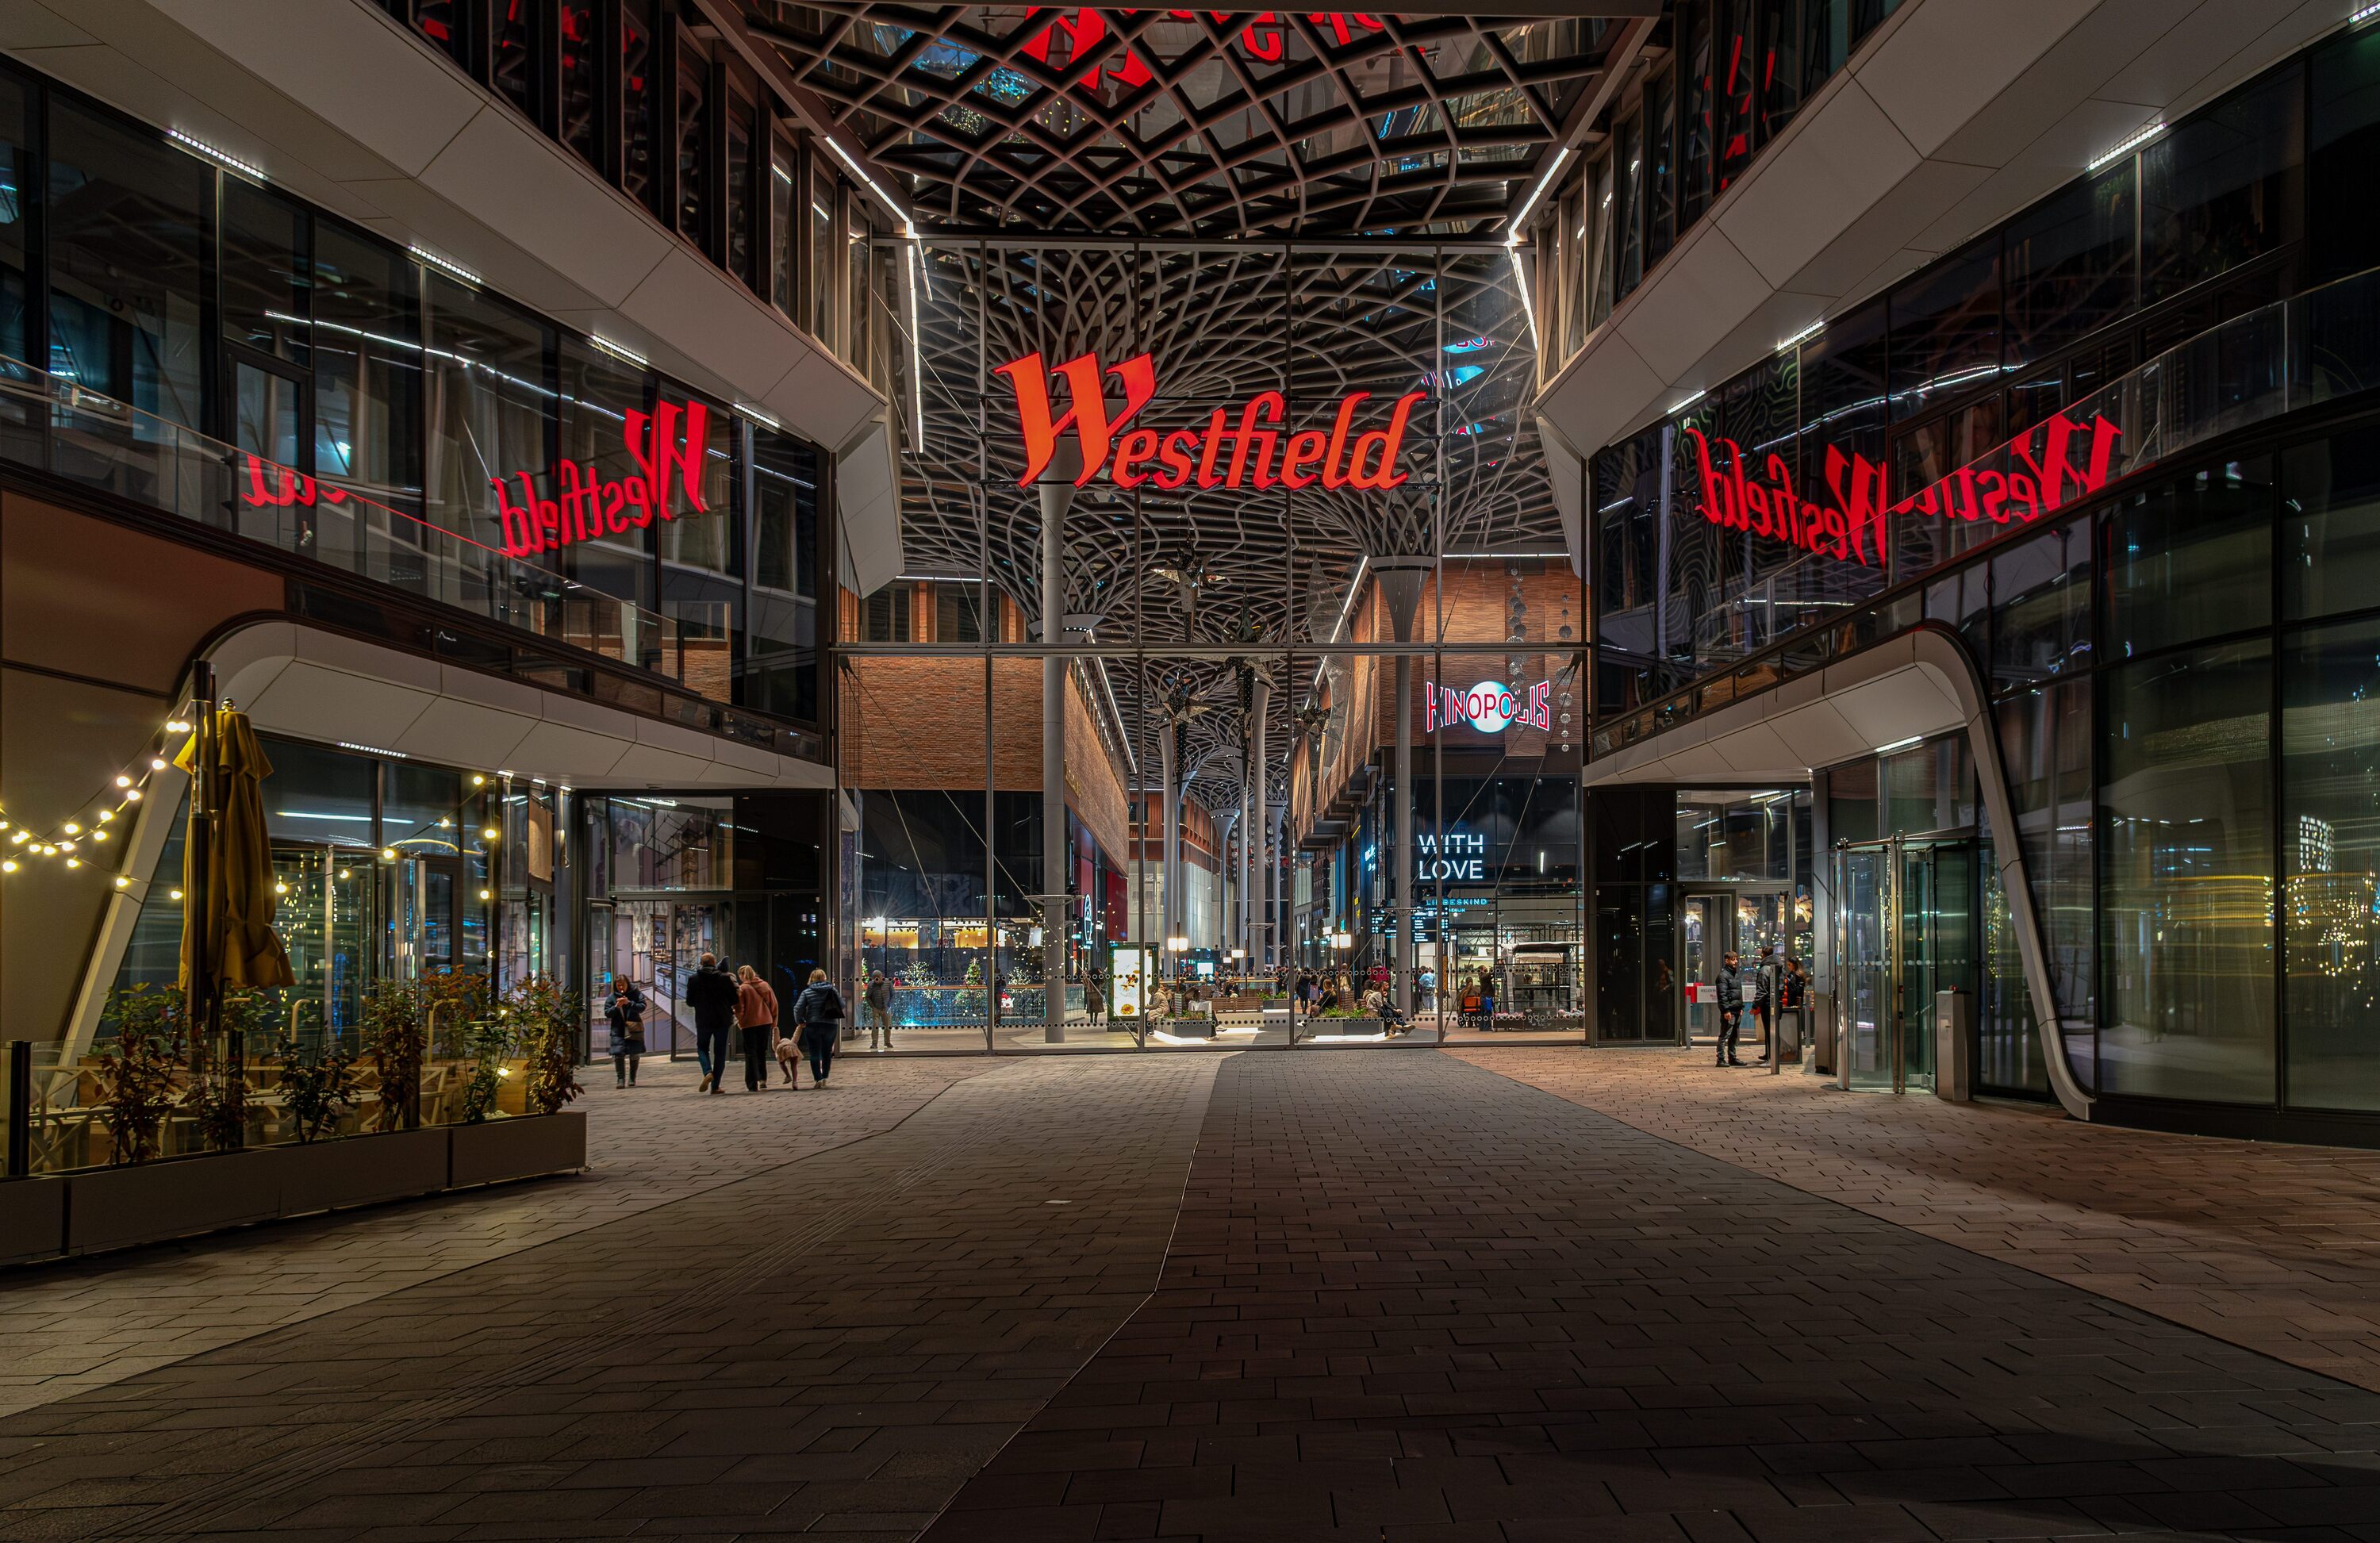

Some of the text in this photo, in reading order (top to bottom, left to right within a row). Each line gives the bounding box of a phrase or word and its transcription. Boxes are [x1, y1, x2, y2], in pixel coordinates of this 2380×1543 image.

[992, 351, 1426, 490] Westfield
[1418, 835, 1484, 854] WITH
[1419, 860, 1484, 880] LOVE
